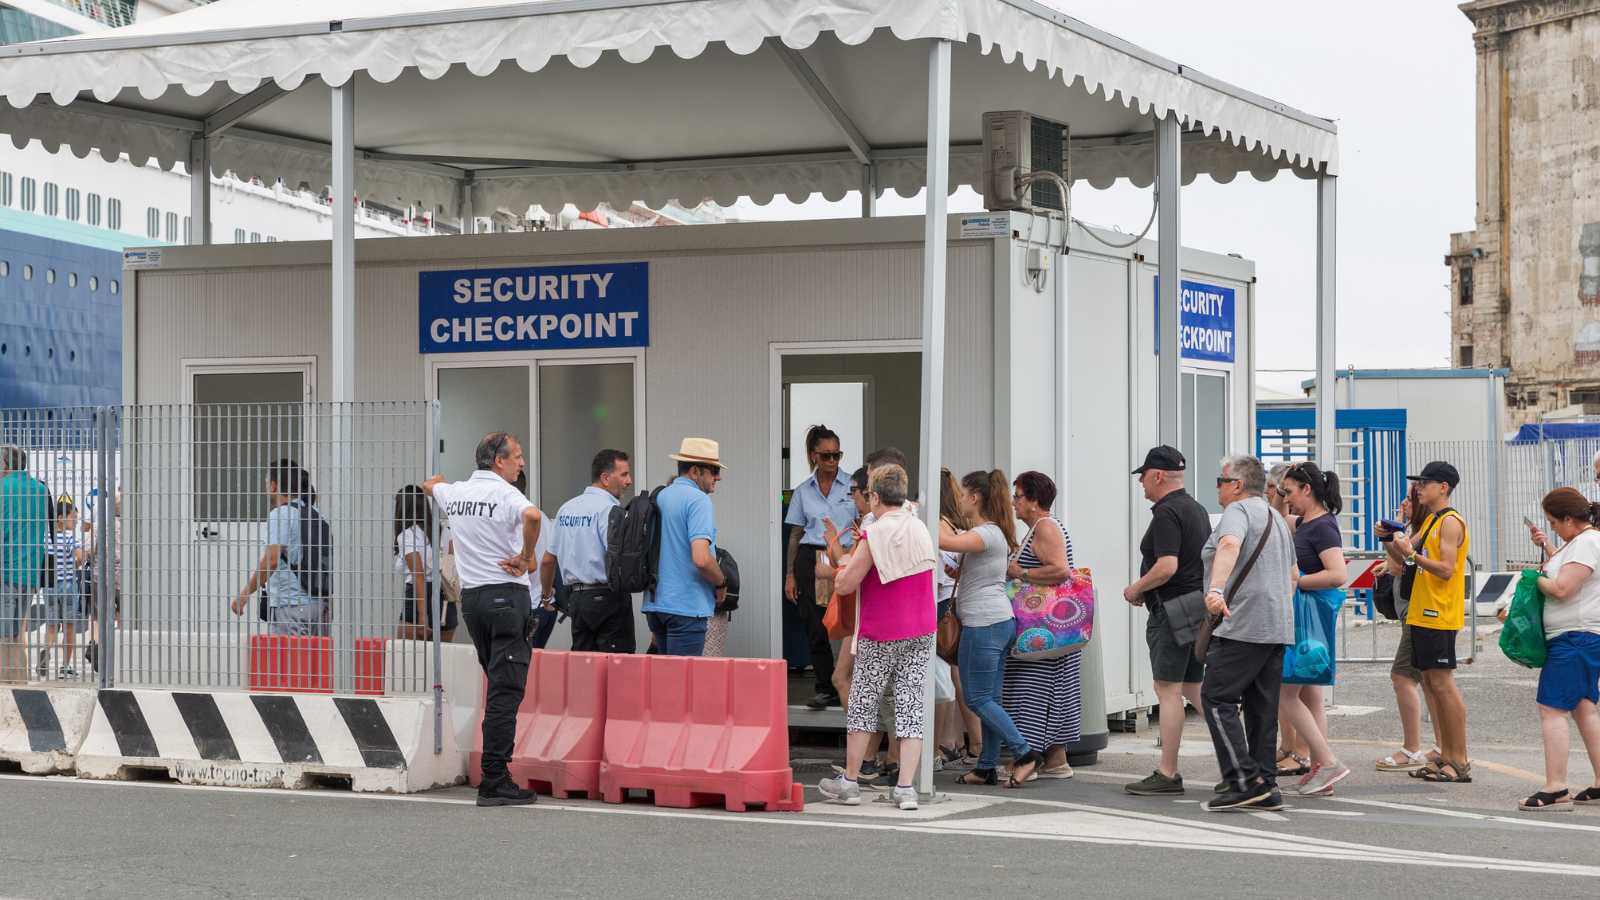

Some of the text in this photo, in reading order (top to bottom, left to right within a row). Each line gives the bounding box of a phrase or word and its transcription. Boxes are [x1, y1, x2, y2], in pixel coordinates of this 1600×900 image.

[452, 273, 613, 304] SECURITY
[430, 311, 638, 343] CHECKPOINT
[445, 500, 498, 518] ECURITY
[559, 515, 592, 527] SECURITY
